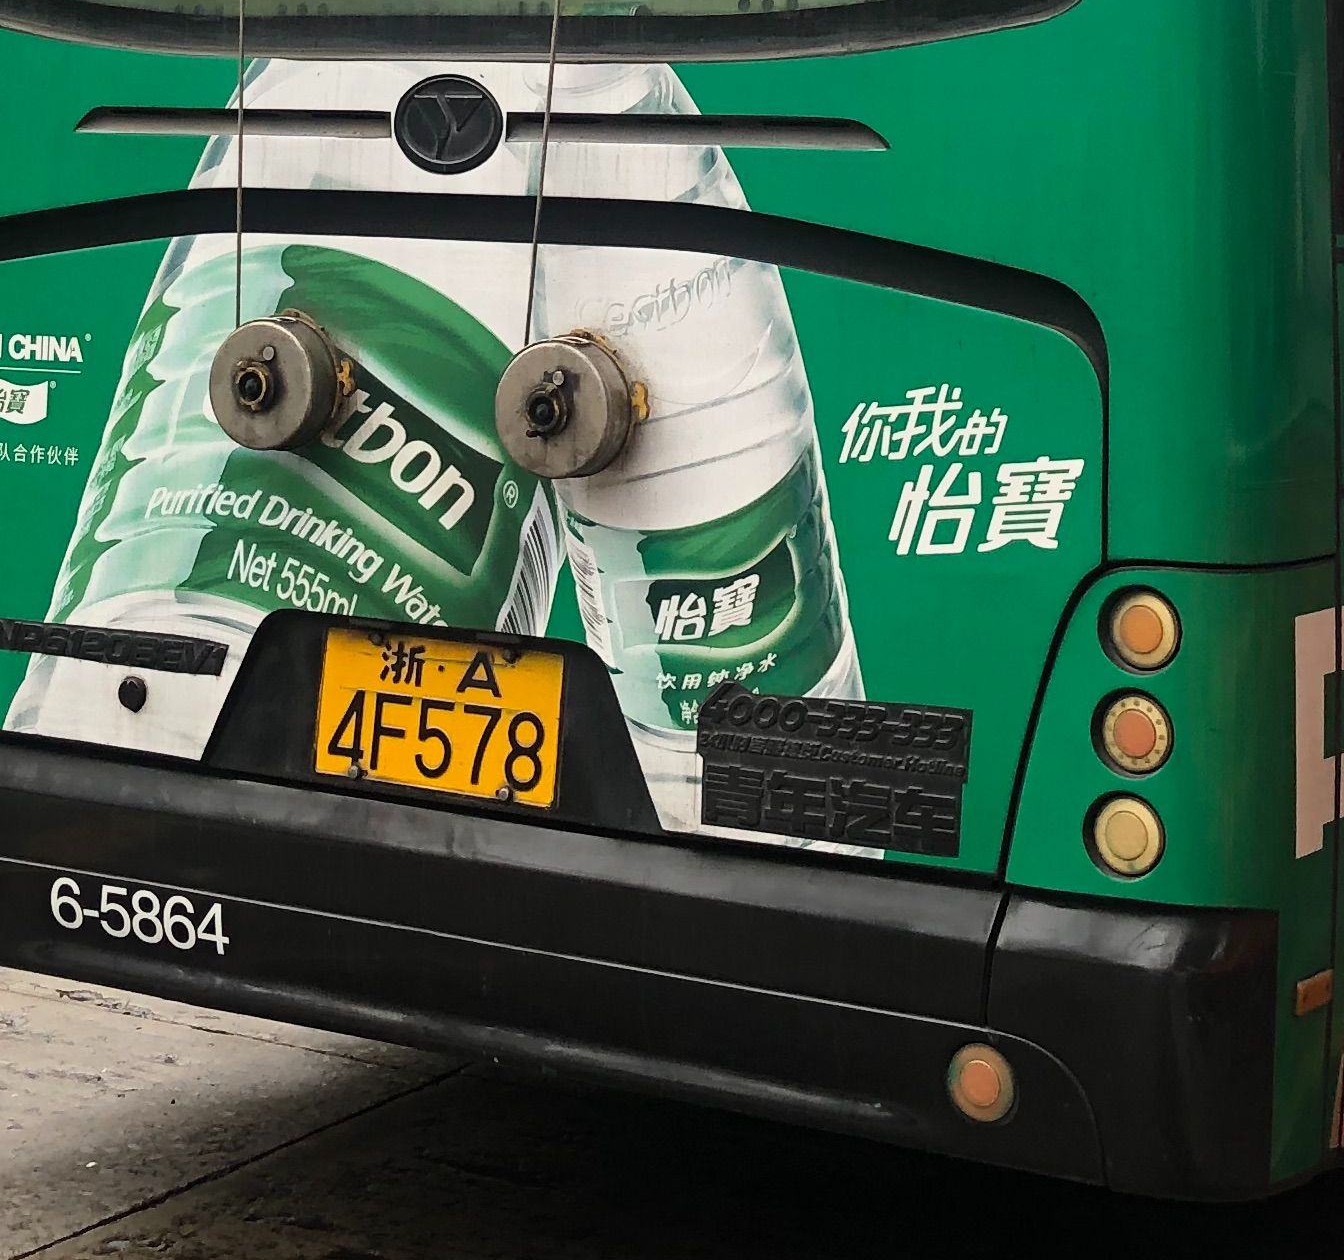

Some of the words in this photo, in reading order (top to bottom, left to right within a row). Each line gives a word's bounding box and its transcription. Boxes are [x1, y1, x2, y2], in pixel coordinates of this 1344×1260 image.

[8, 333, 84, 363] CHINA
[321, 388, 475, 531] tbon
[838, 383, 1009, 464] 你我的
[144, 482, 263, 522] Purified
[258, 494, 385, 584] Drinking
[887, 455, 1086, 556] 怡寶
[226, 538, 278, 592] Net
[654, 573, 761, 641] 怡寶
[326, 689, 546, 792] 4F578
[703, 763, 957, 847] 青年汽车
[50, 876, 231, 956] 6-5864
